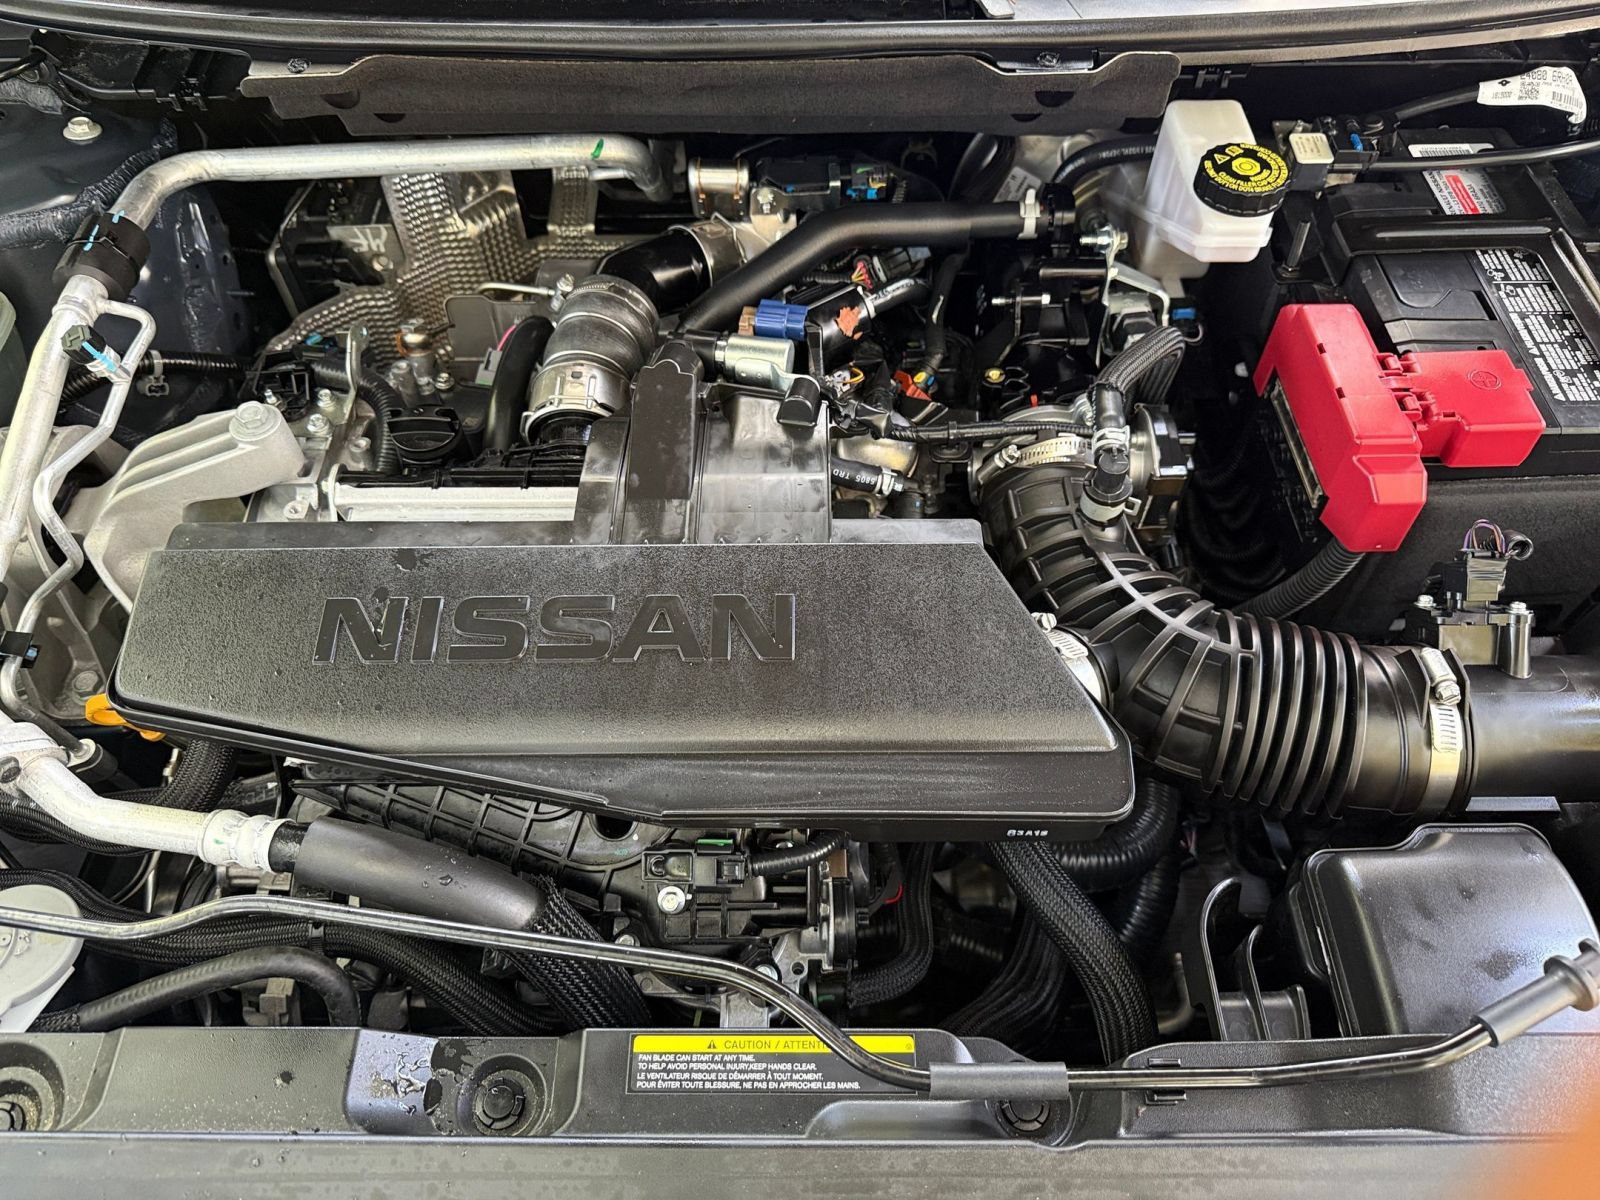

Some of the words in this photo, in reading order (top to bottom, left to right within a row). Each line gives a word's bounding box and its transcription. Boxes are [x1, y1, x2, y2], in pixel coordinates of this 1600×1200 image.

[832, 468, 850, 480] TRD
[312, 594, 796, 664] NISSAN
[724, 1040, 771, 1050] CAUTION
[784, 1040, 826, 1050] ATTENTI
[729, 1070, 766, 1080] DÉMARRER
[767, 1070, 772, 1080] À
[658, 1079, 680, 1088] ÉVITER
